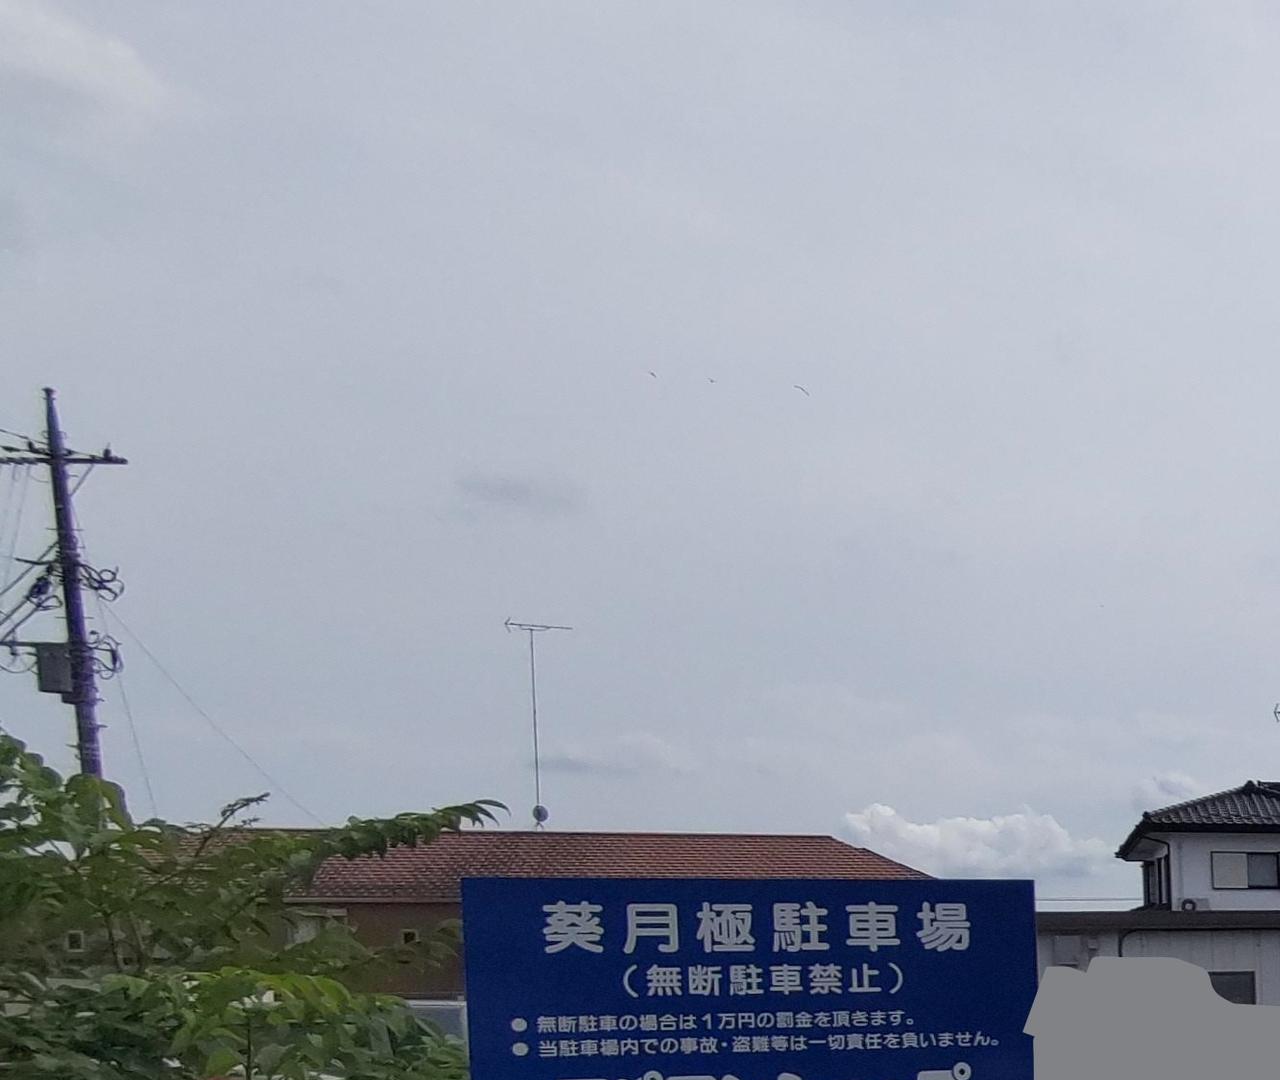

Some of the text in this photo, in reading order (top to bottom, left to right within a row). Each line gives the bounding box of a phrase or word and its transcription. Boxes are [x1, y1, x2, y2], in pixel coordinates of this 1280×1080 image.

[542, 901, 971, 953] 葵月極駐車場
[622, 962, 904, 997] (無断駐車禁止)
[536, 1011, 915, 1032] 無断駐車の場合は1万円の罰金を頂きます。
